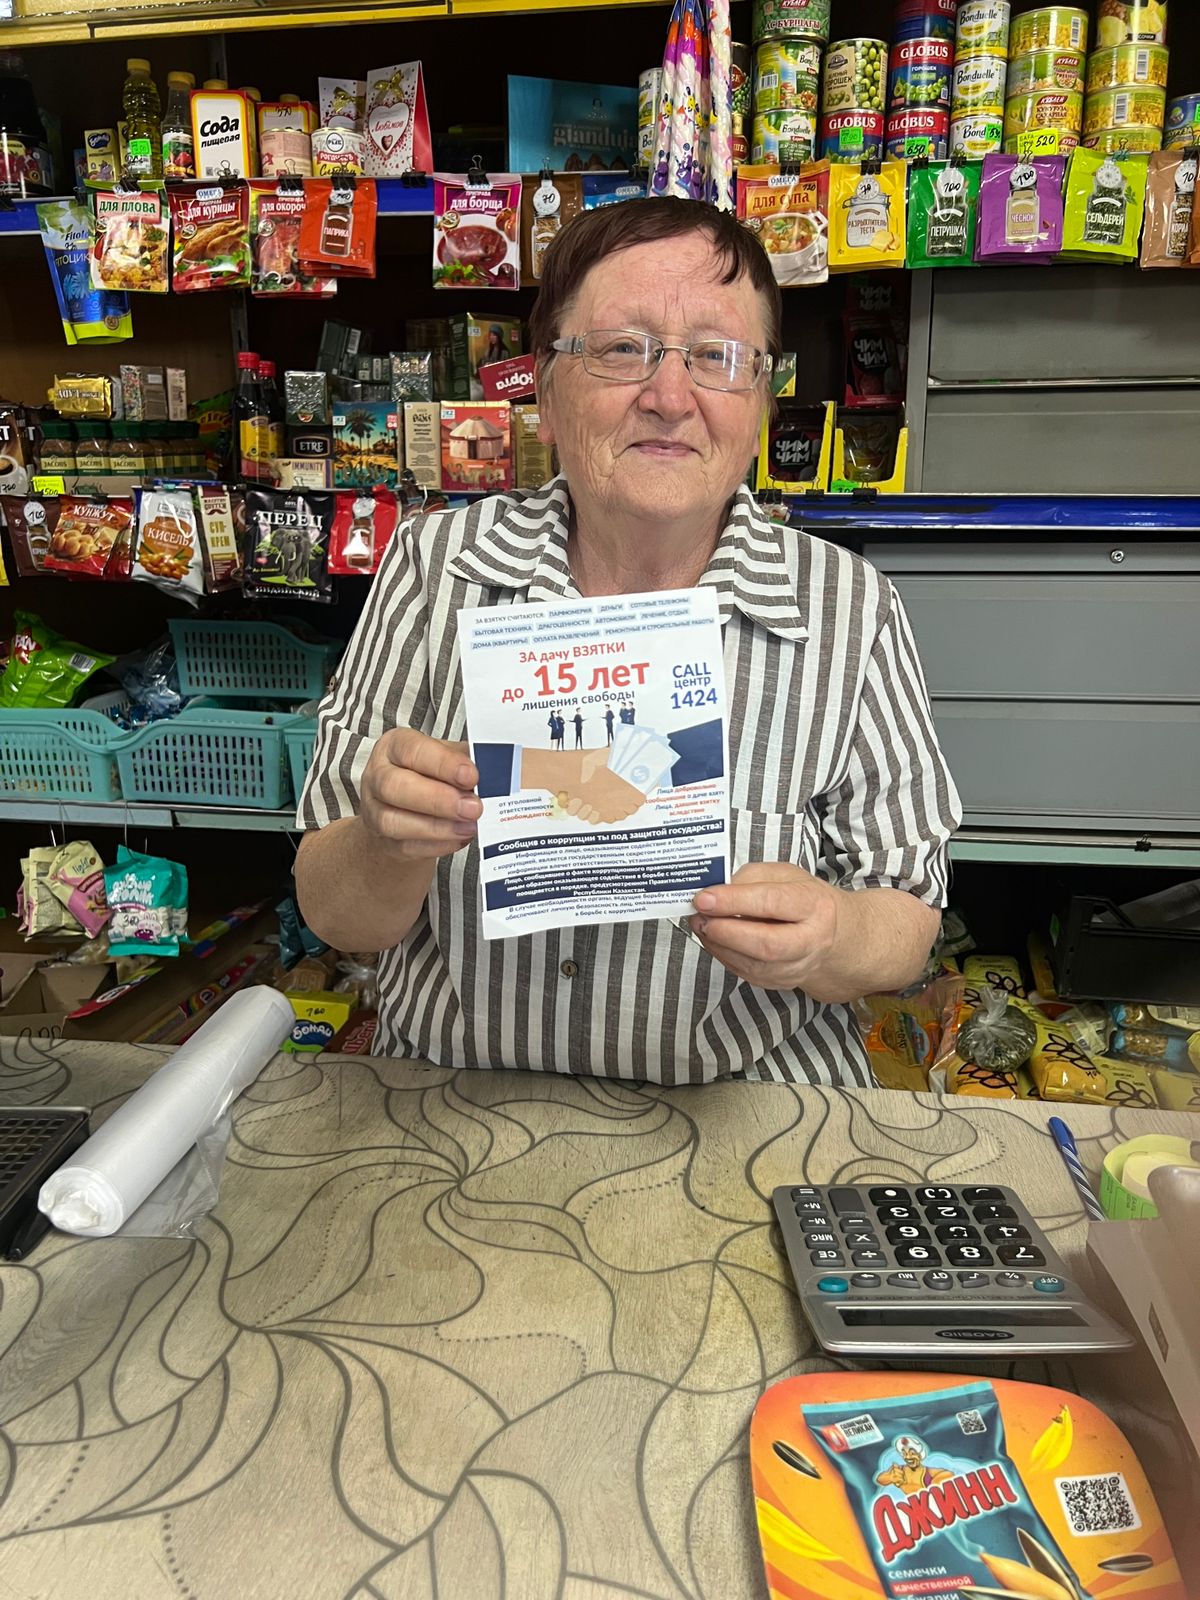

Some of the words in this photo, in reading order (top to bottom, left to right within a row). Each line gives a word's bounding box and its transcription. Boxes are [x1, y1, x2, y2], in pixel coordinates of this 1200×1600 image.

[960, 10, 998, 24] Bonduelle
[901, 45, 948, 59] GLOBUS
[957, 69, 995, 85] Bonduelle
[200, 116, 240, 138] Сода
[829, 117, 876, 130] GLOBUS
[888, 116, 934, 131] GLOBUS
[963, 124, 987, 139] Bond
[201, 133, 240, 149] пищевая
[1035, 135, 1055, 147] 520
[907, 144, 925, 155] 650
[99, 200, 118, 212] для
[121, 201, 156, 214] плова
[275, 202, 306, 214] окороч
[451, 198, 468, 211] для
[469, 196, 503, 212] борща
[753, 196, 776, 210] для
[203, 202, 236, 221] курицы
[1086, 212, 1124, 226] СЕЛЬДЕРЕЙ
[324, 227, 350, 238] ПАПРИКА
[931, 225, 964, 237] ПЕТРУШКА
[854, 339, 883, 351] ЧИМ
[857, 351, 888, 366] ЧИМ
[300, 441, 324, 453] ETRE
[776, 440, 810, 451] ЧИМ
[776, 450, 810, 463] ЧИМ
[292, 462, 323, 471] IMMUNITY
[73, 505, 115, 521] КУНЖУТ
[256, 510, 324, 530] ПЕРЕЦ
[147, 527, 189, 546] КИСЕЛЬ
[549, 608, 592, 617] ПАРФЮМЕРИЯ
[600, 604, 623, 612] ДЕНЬГИ
[630, 600, 656, 609] СОТОВЫЕ
[658, 597, 689, 606] ТЕЛЕФОНЫ
[474, 628, 504, 637] БЫТОВАЯ
[505, 625, 532, 634] ТЕХНИКА
[537, 620, 590, 631] ДРАГОЦЕННОСТИ
[595, 615, 636, 624] АВТОМОБИЛИ
[667, 609, 688, 617] ОТДЫХ
[472, 642, 492, 650] ДОМА
[533, 635, 557, 643] ОПЛАТА
[605, 625, 640, 635] РЕМОНТНЫЕ
[647, 620, 690, 631] СТРОИТЕЛЬНЫЕ
[691, 618, 714, 626] РАБОТЫ
[519, 651, 537, 663] ЗА
[540, 650, 570, 664] дачу
[573, 641, 625, 658] ВЗЯТКИ
[672, 662, 712, 678] CALL
[501, 688, 524, 703] до
[534, 662, 577, 696] 15
[587, 662, 650, 690] лет
[674, 676, 711, 690] центр
[521, 696, 578, 711] лишения
[581, 690, 635, 704] свободы
[670, 687, 718, 710] 1424
[508, 796, 542, 807] уголовной
[499, 804, 554, 815] ответственности
[498, 839, 539, 852] Сообщив
[547, 835, 596, 846] коррупции
[611, 833, 628, 841] под
[629, 828, 667, 840] защитой
[668, 821, 723, 835] государства!
[515, 849, 557, 859] Информация
[573, 889, 612, 897] Республики
[803, 1202, 821, 1211] M+
[890, 1207, 909, 1217] 3
[938, 1207, 957, 1217] 2
[899, 1226, 919, 1237] 6
[818, 1250, 837, 1259] CE
[908, 1247, 929, 1259] 9
[959, 1247, 981, 1259] 8
[1015, 1247, 1034, 1259] 7
[844, 1422, 875, 1438] ВЕЛИКАН
[873, 1464, 1018, 1563] ДЖИНН
[888, 1566, 947, 1580] семечки
[894, 1576, 972, 1592] качественной
